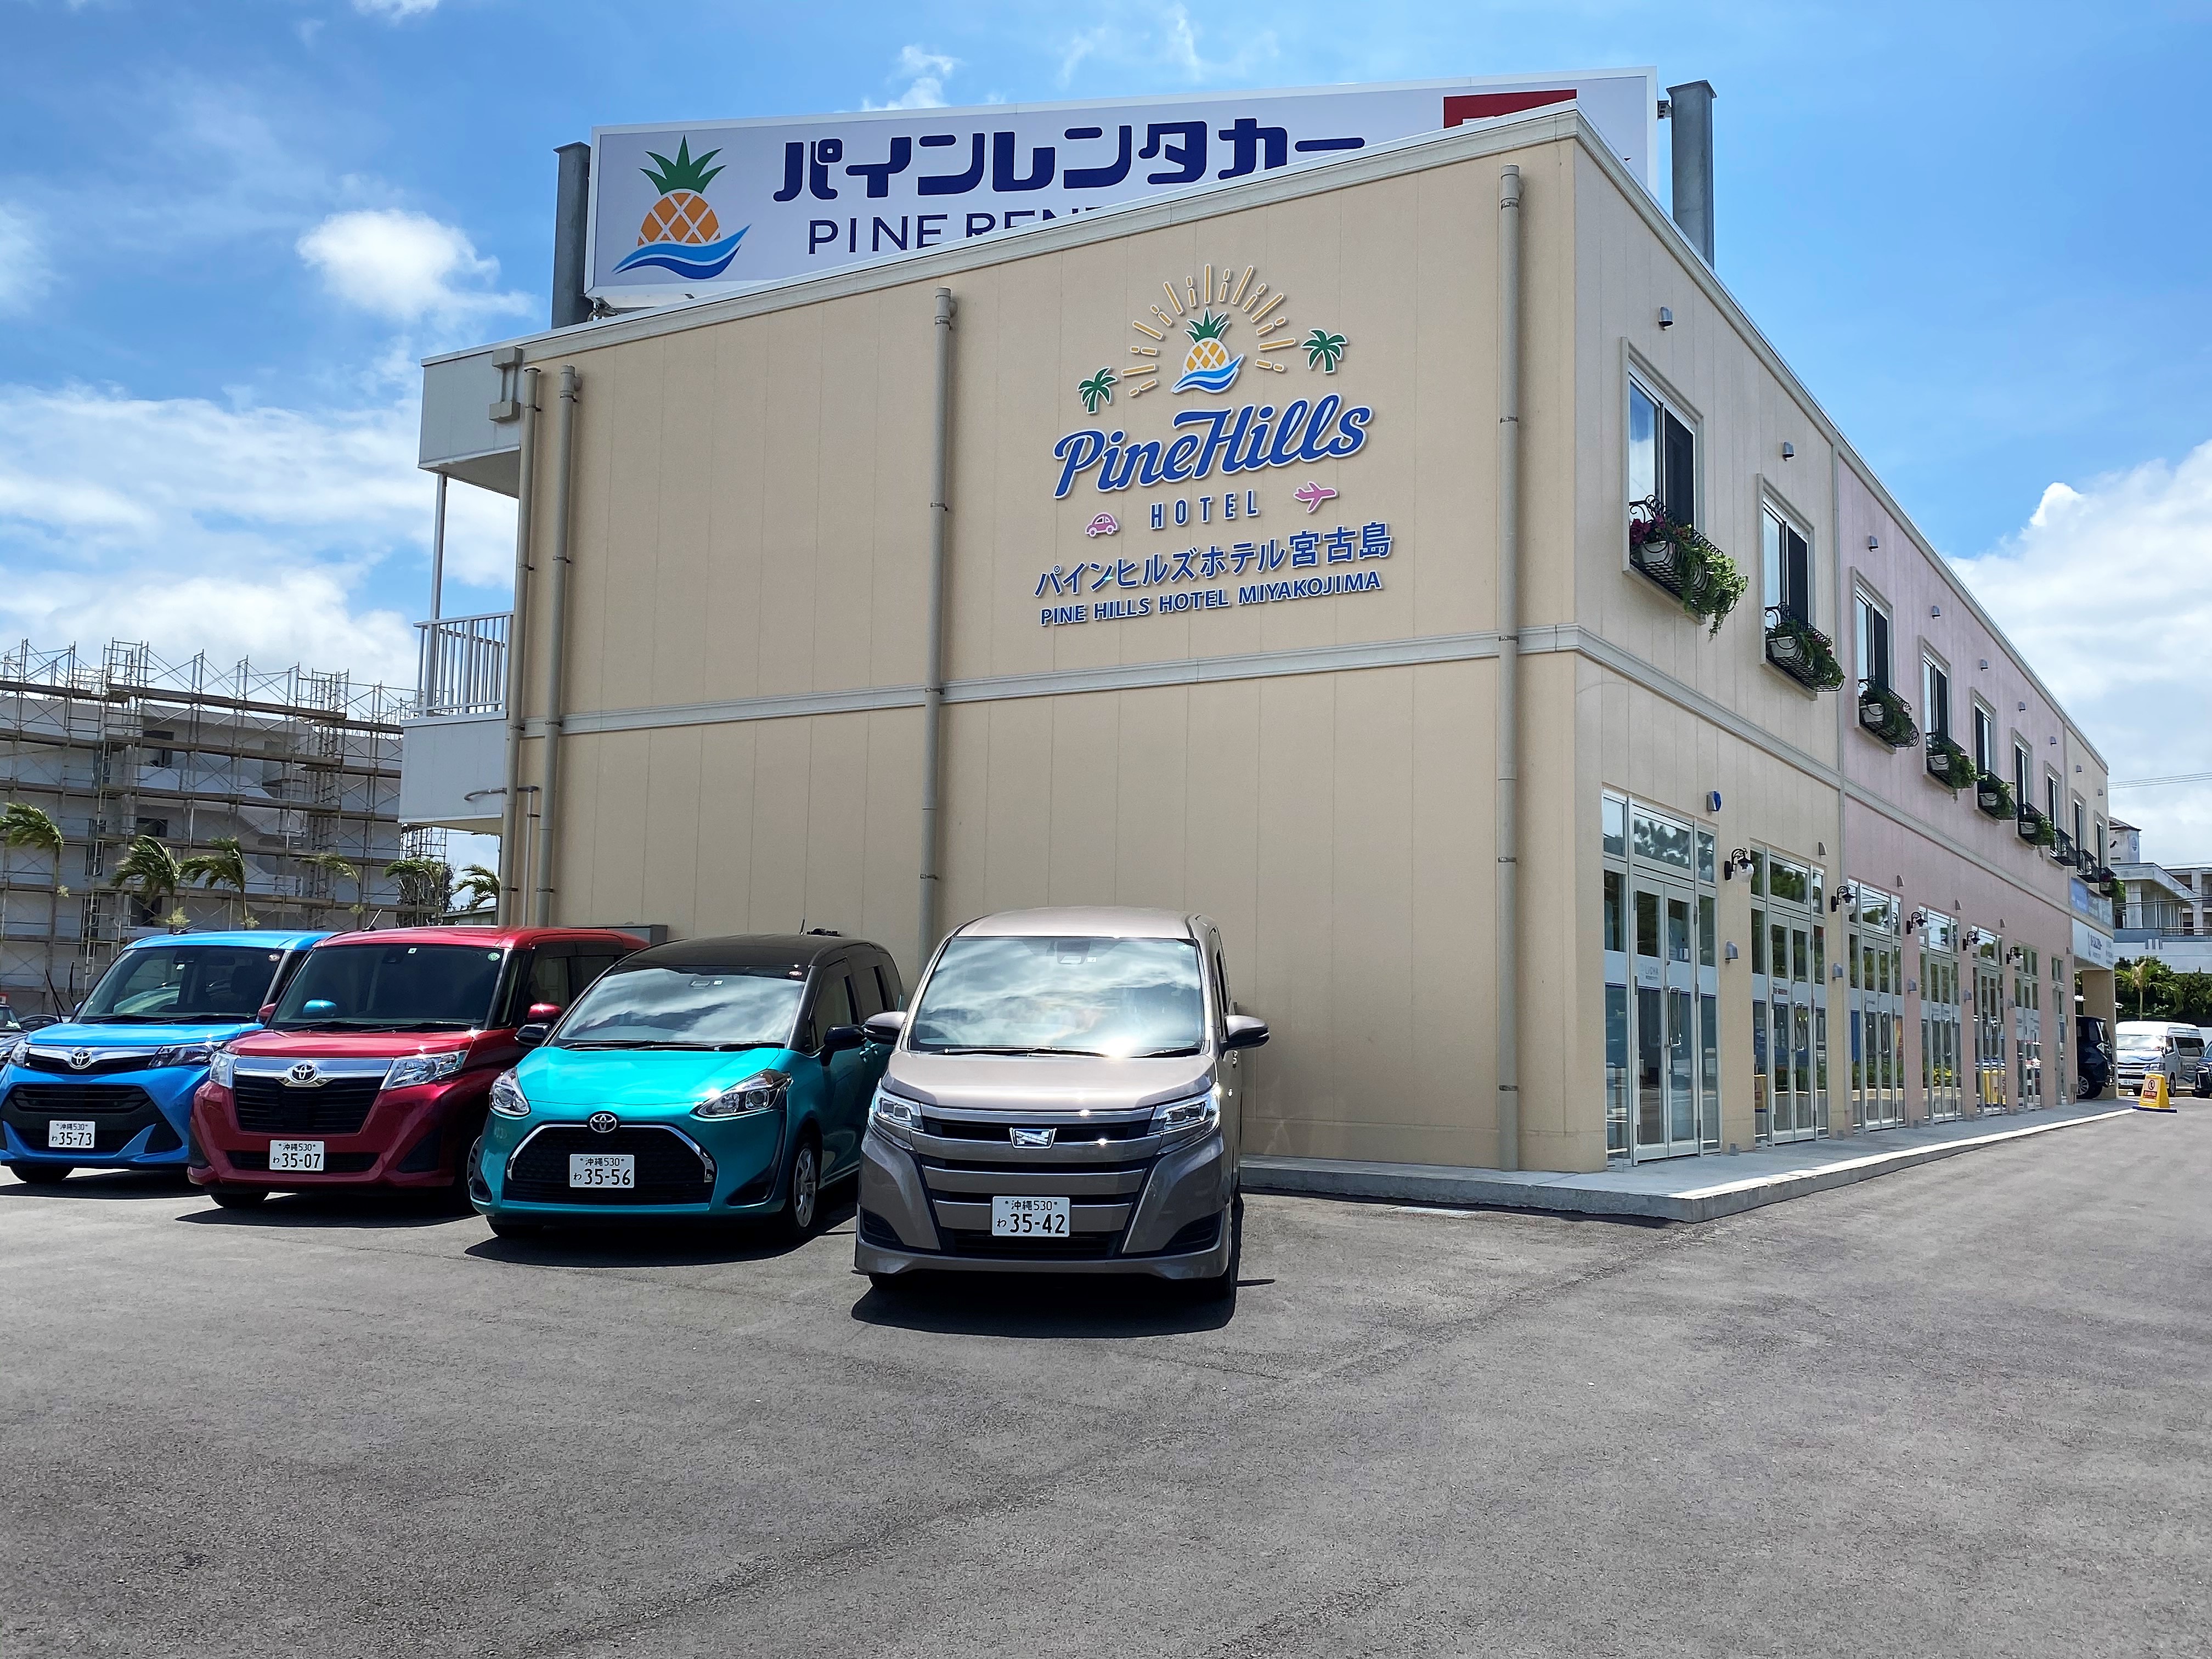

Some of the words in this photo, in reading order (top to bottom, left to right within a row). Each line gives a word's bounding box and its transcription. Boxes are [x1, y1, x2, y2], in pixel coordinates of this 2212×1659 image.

[773, 119, 1365, 202] パインレンタカー
[809, 213, 948, 255] PINE
[1150, 489, 1261, 529] HOTEL
[1035, 521, 1392, 597] パインヒルズホテル宮古島
[1040, 605, 1086, 626] PINE
[1093, 597, 1151, 620] HILLS
[1159, 589, 1229, 613] HOTEL
[1239, 571, 1381, 605] MIYAKOJIMA
[59, 1132, 92, 1146] 35-73
[281, 1153, 321, 1169] 35-07
[573, 1172, 582, 1181] わ
[584, 1168, 630, 1186] 35-56
[997, 1218, 1007, 1228] わ
[1009, 1213, 1065, 1234] 35-42
